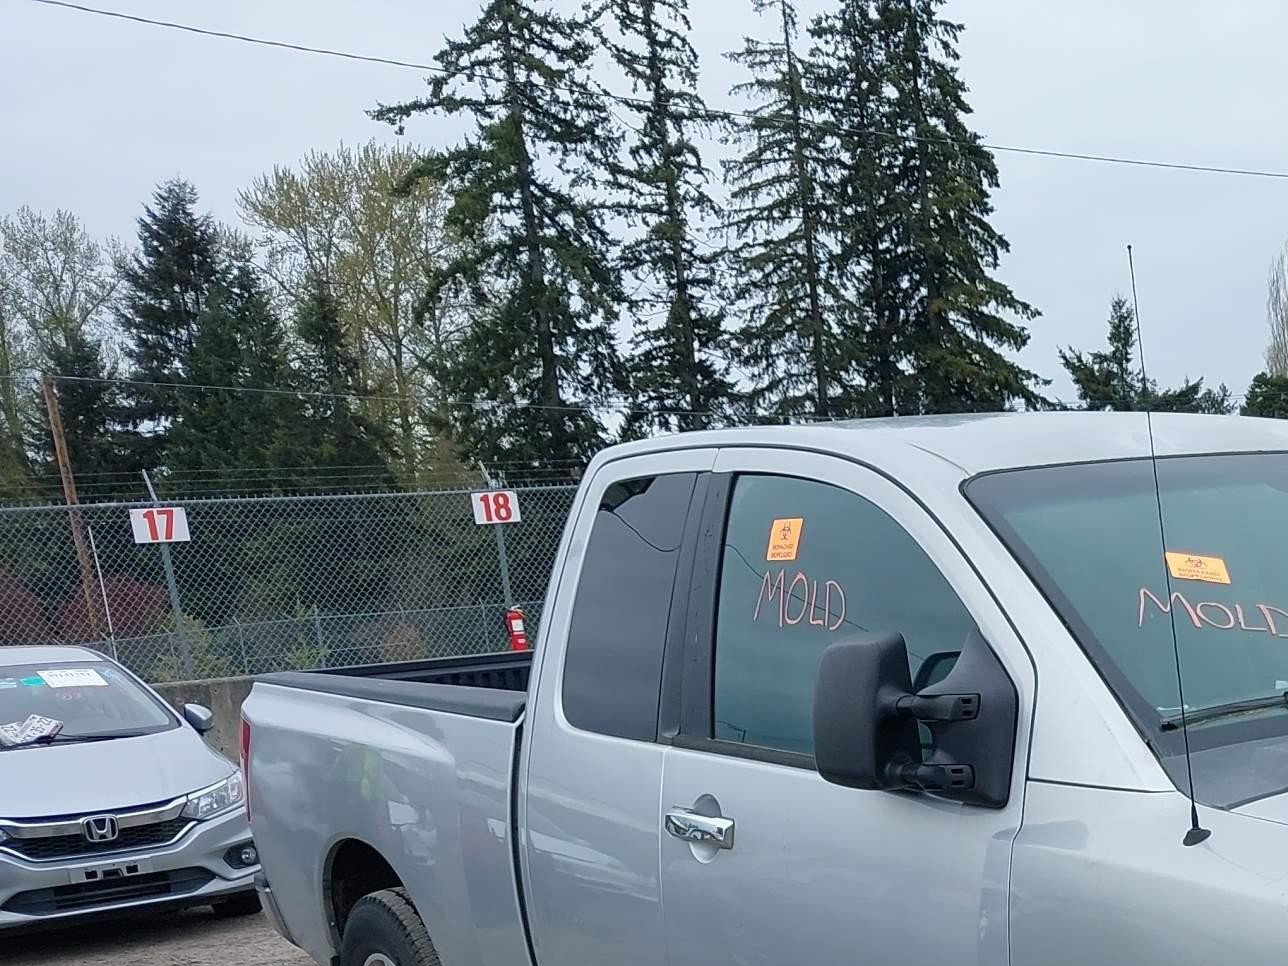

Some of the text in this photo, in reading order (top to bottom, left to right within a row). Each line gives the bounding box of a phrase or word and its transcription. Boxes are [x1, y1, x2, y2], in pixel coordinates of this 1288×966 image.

[479, 493, 512, 522] 18
[142, 509, 174, 541] 17
[753, 568, 846, 631] MOLD
